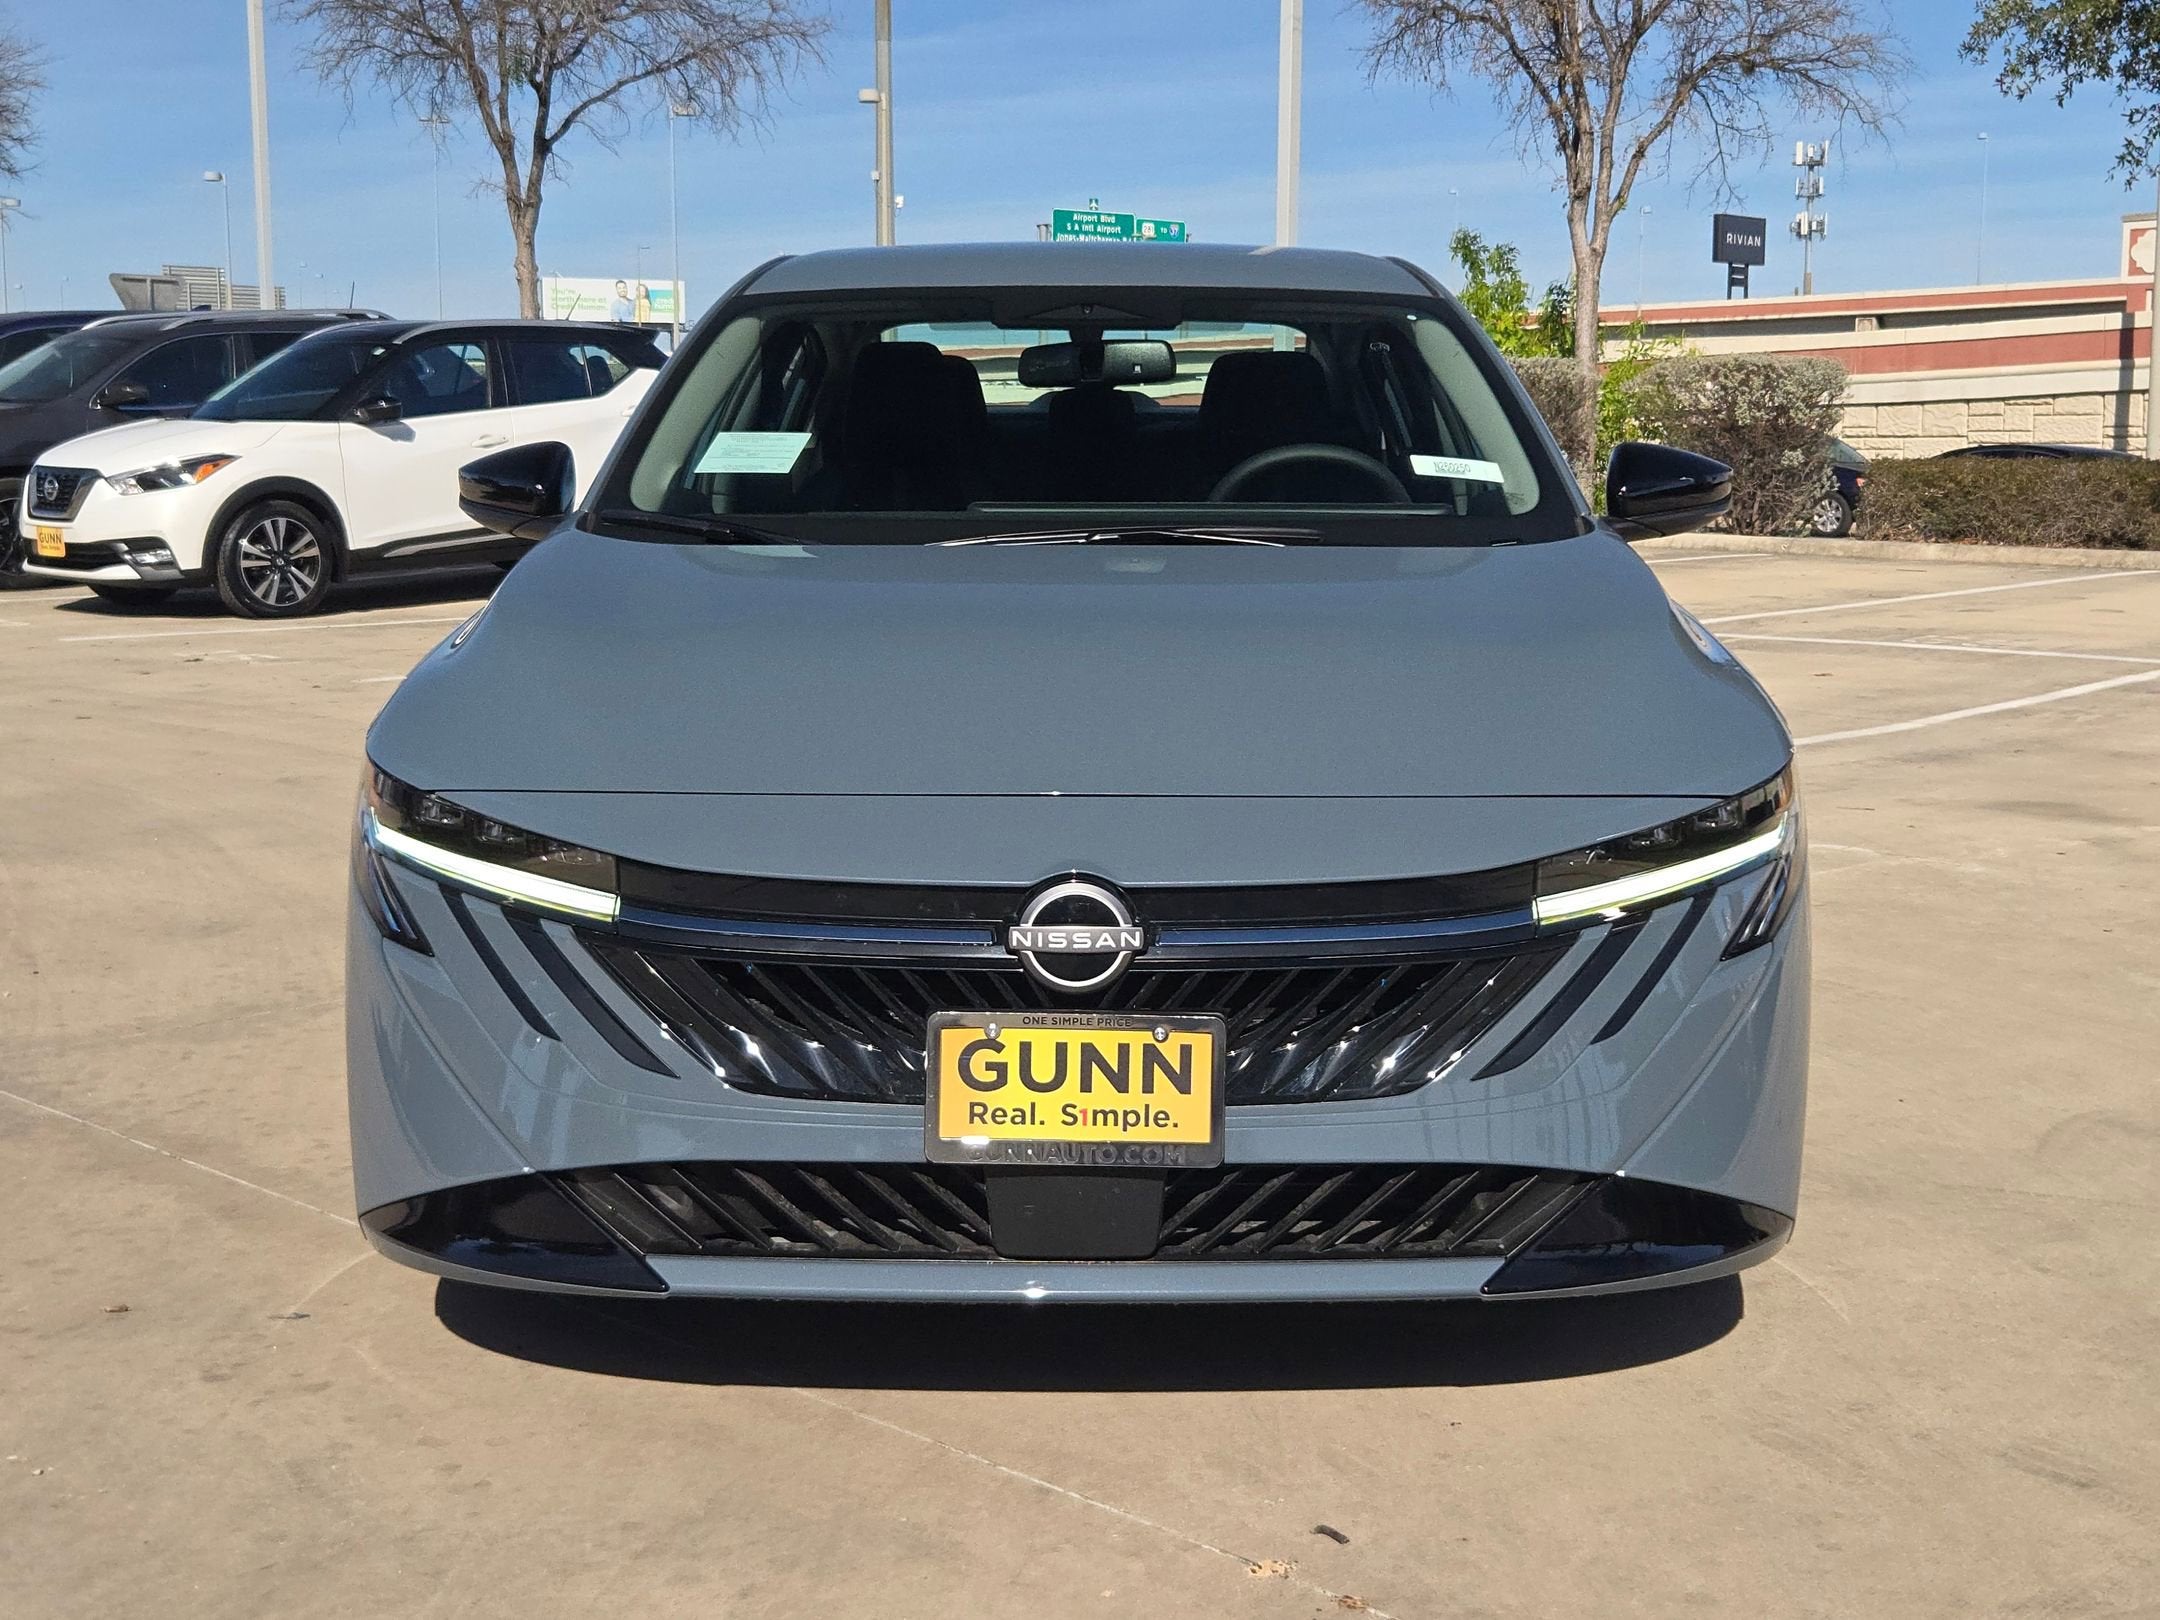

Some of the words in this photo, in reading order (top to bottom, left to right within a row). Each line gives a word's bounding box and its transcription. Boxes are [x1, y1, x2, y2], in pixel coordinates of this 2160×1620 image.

[1073, 213, 1098, 223] Airport
[1100, 215, 1116, 223] Blvd
[1067, 223, 1072, 231] S
[1082, 224, 1095, 232] Intl
[1097, 225, 1121, 234] Airport
[1726, 233, 1761, 247] RIVIAN
[39, 532, 62, 544] GUNN
[1011, 930, 1141, 949] NISSAN
[1022, 1015, 1049, 1026] ONE
[1051, 1016, 1093, 1027] SIMPLE
[1096, 1017, 1132, 1028] PRICE
[957, 1038, 1193, 1096] GUNN
[968, 1100, 1046, 1127] Real.
